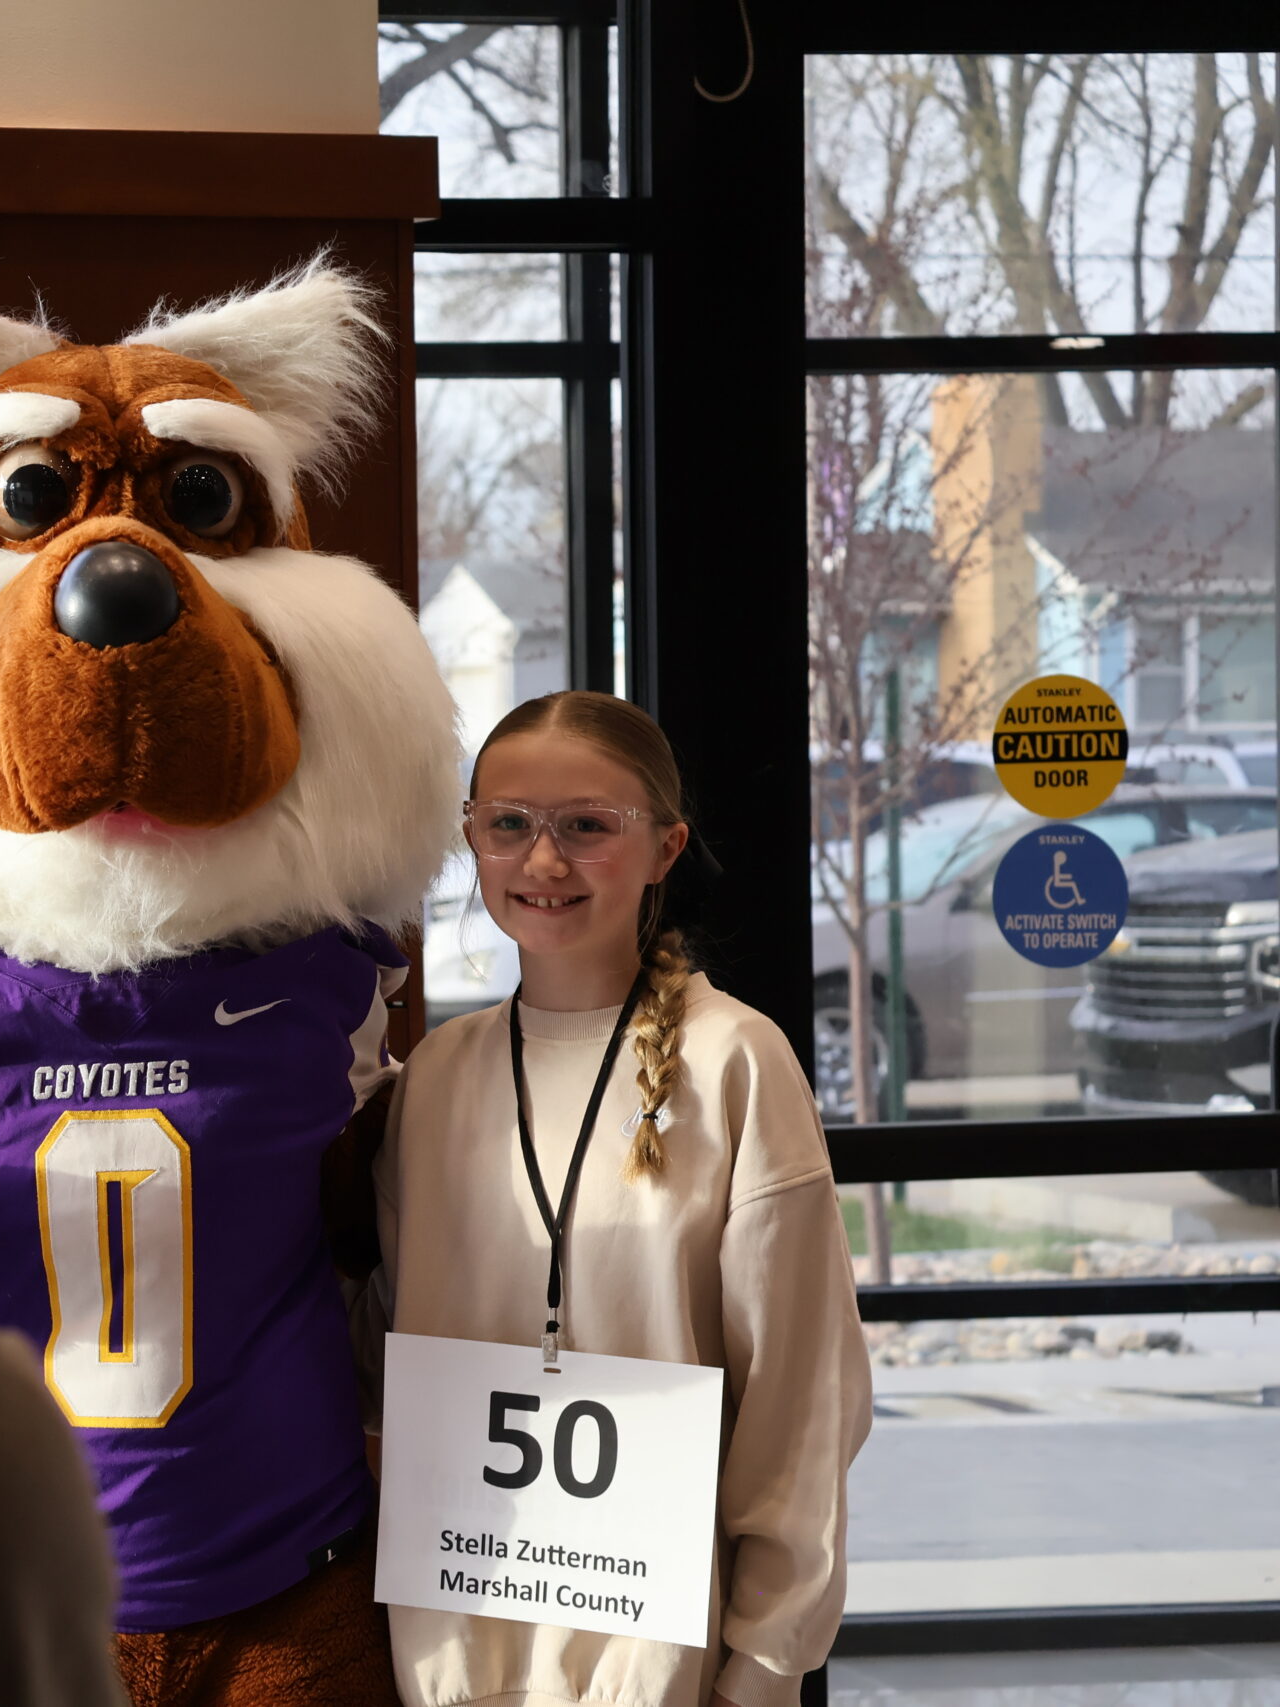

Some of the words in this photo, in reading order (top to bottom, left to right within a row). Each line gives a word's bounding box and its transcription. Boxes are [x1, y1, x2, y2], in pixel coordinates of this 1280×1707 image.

[1036, 687, 1082, 698] STANLEY
[1004, 704, 1117, 725] AUTOMATIC
[997, 731, 1120, 761] CAUTION
[1034, 769, 1089, 788] DOOR
[1038, 835, 1085, 845] STANLEY
[1005, 914, 1063, 930] ACTIVATE
[1067, 913, 1117, 930] SWITCH
[1023, 932, 1039, 949] TO
[1042, 932, 1099, 949] OPERATE
[32, 1059, 190, 1100] COYOTES
[34, 1108, 193, 1430] 0
[482, 1390, 619, 1499] 50
[440, 1529, 508, 1559] Stella
[516, 1538, 647, 1578] Zutterman
[439, 1568, 548, 1604] Marshall
[556, 1584, 645, 1622] County
